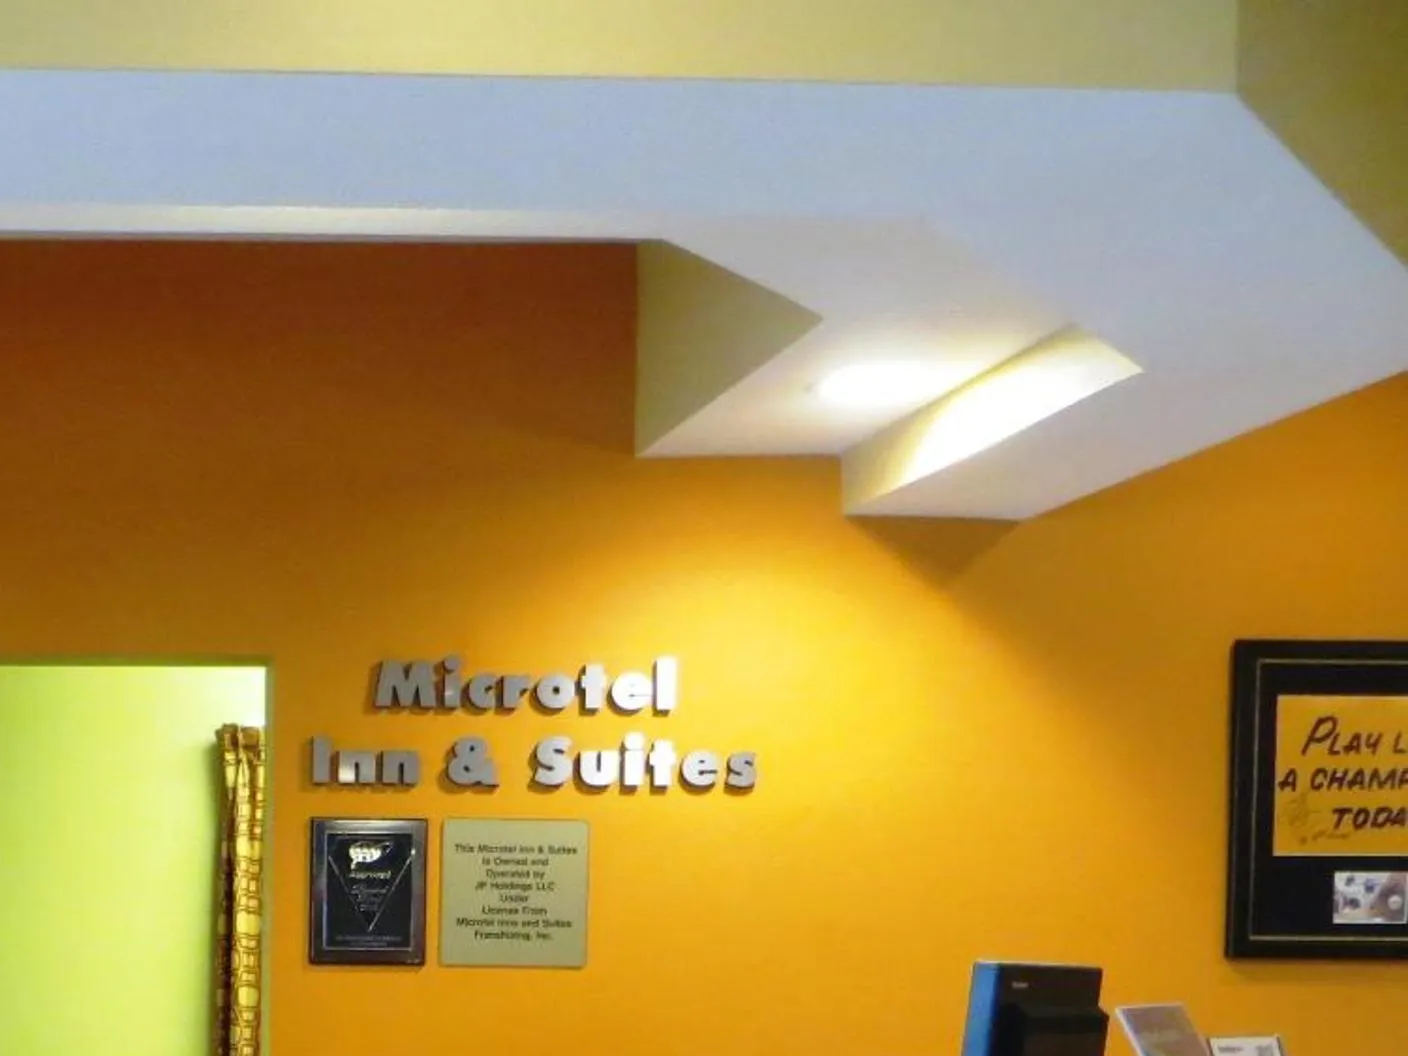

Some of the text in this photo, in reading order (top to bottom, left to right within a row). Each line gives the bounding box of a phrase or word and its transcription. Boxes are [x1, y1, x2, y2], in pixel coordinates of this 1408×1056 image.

[375, 655, 678, 713] Microtel
[311, 731, 758, 790] Inn & Suites
[1278, 768, 1297, 792] A
